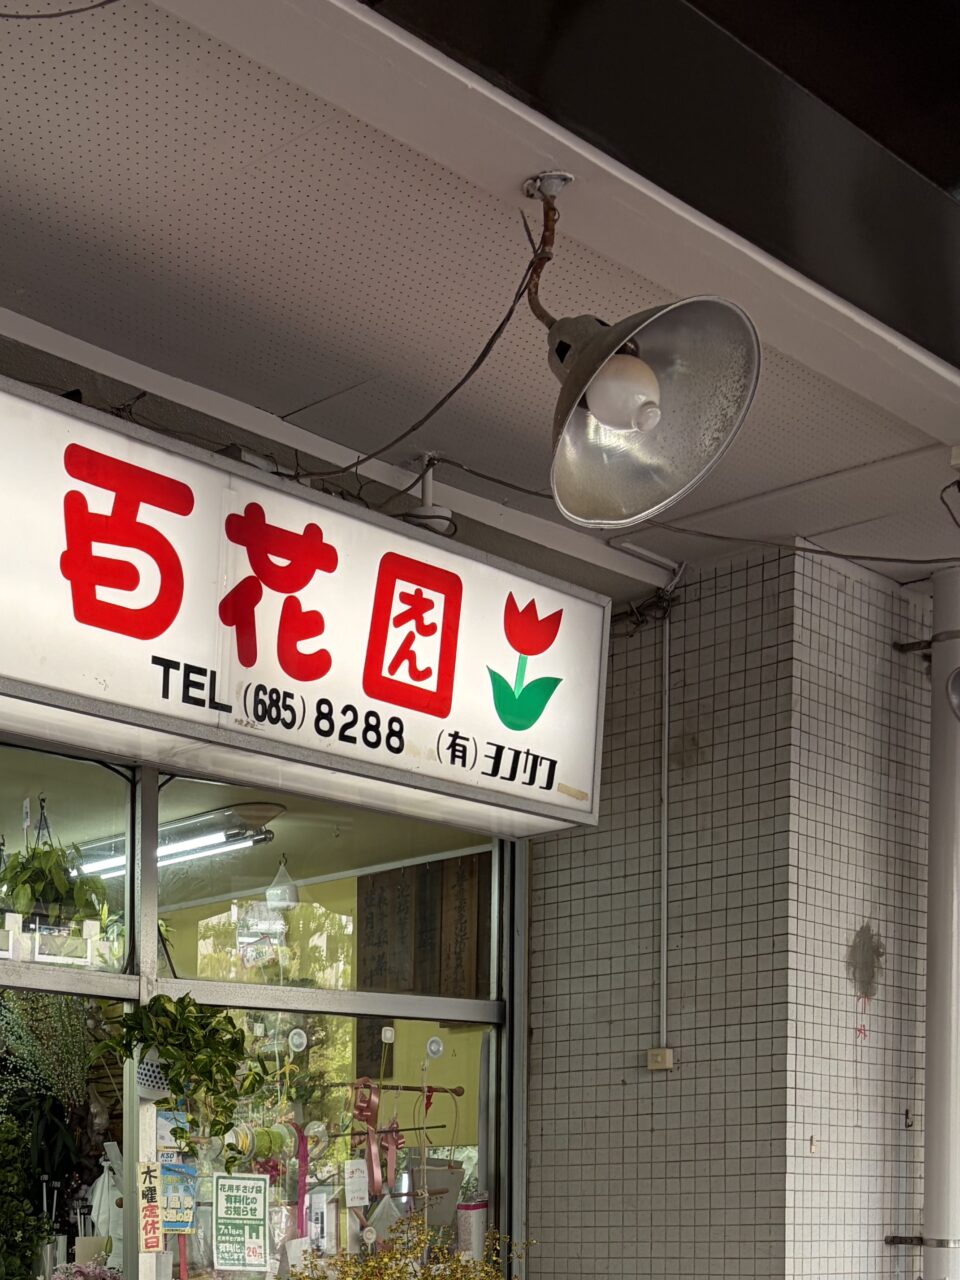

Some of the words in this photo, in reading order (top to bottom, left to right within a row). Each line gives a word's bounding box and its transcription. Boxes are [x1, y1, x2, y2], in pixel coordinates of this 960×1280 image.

[151, 655, 233, 714] TEL
[219, 1184, 263, 1194] 花用手さげ袋
[224, 1194, 258, 1206] 有料化の
[141, 1166, 161, 1250] 木曜定休日
[224, 1206, 258, 1217] お知らせ
